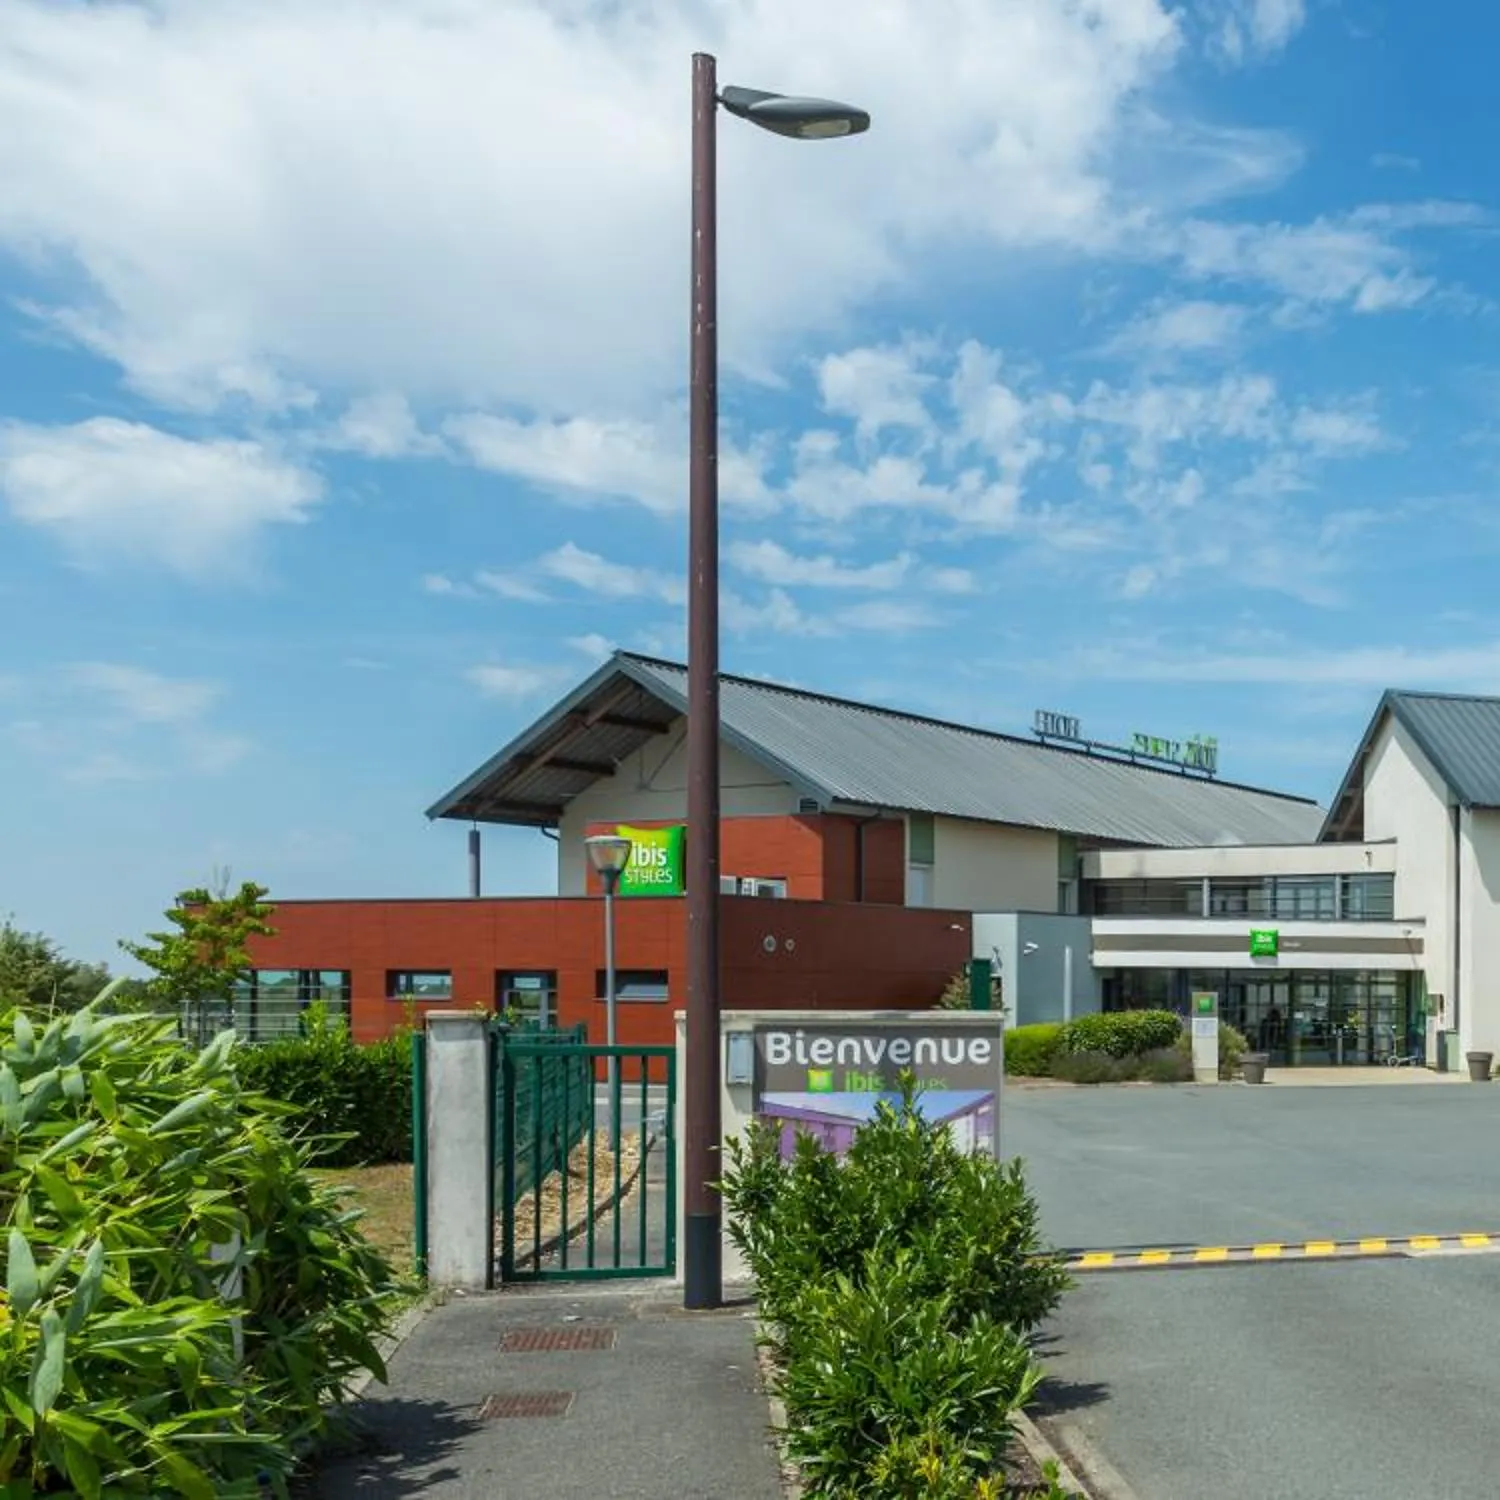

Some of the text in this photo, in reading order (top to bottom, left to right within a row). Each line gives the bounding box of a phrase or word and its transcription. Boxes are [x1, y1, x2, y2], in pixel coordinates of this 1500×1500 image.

[631, 842, 667, 868] ibis
[765, 1030, 991, 1065] Bienvenue
[845, 1070, 886, 1092] ibis
